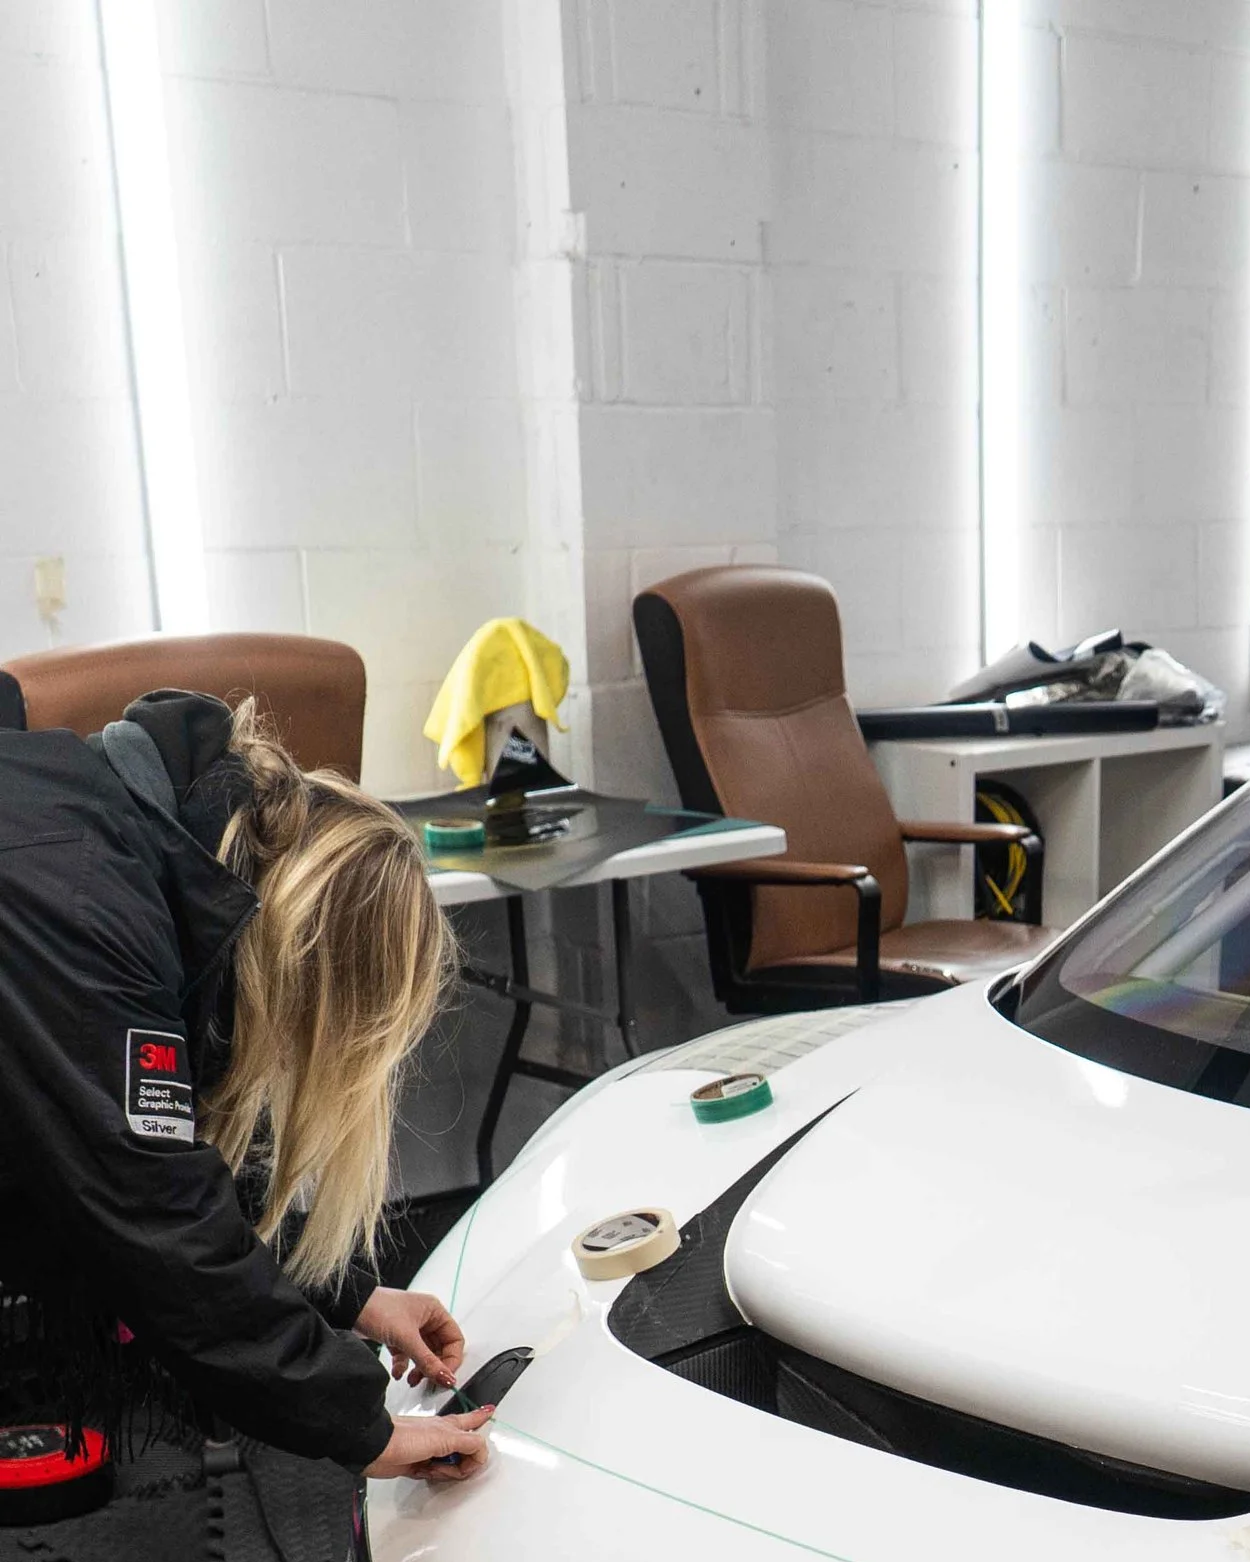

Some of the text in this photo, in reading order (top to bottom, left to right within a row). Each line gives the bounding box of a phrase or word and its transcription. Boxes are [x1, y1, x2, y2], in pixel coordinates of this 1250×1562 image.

[139, 1043, 176, 1072] 3M
[139, 1086, 170, 1098] Select
[138, 1098, 173, 1111] Graphic
[142, 1119, 177, 1135] Silver
